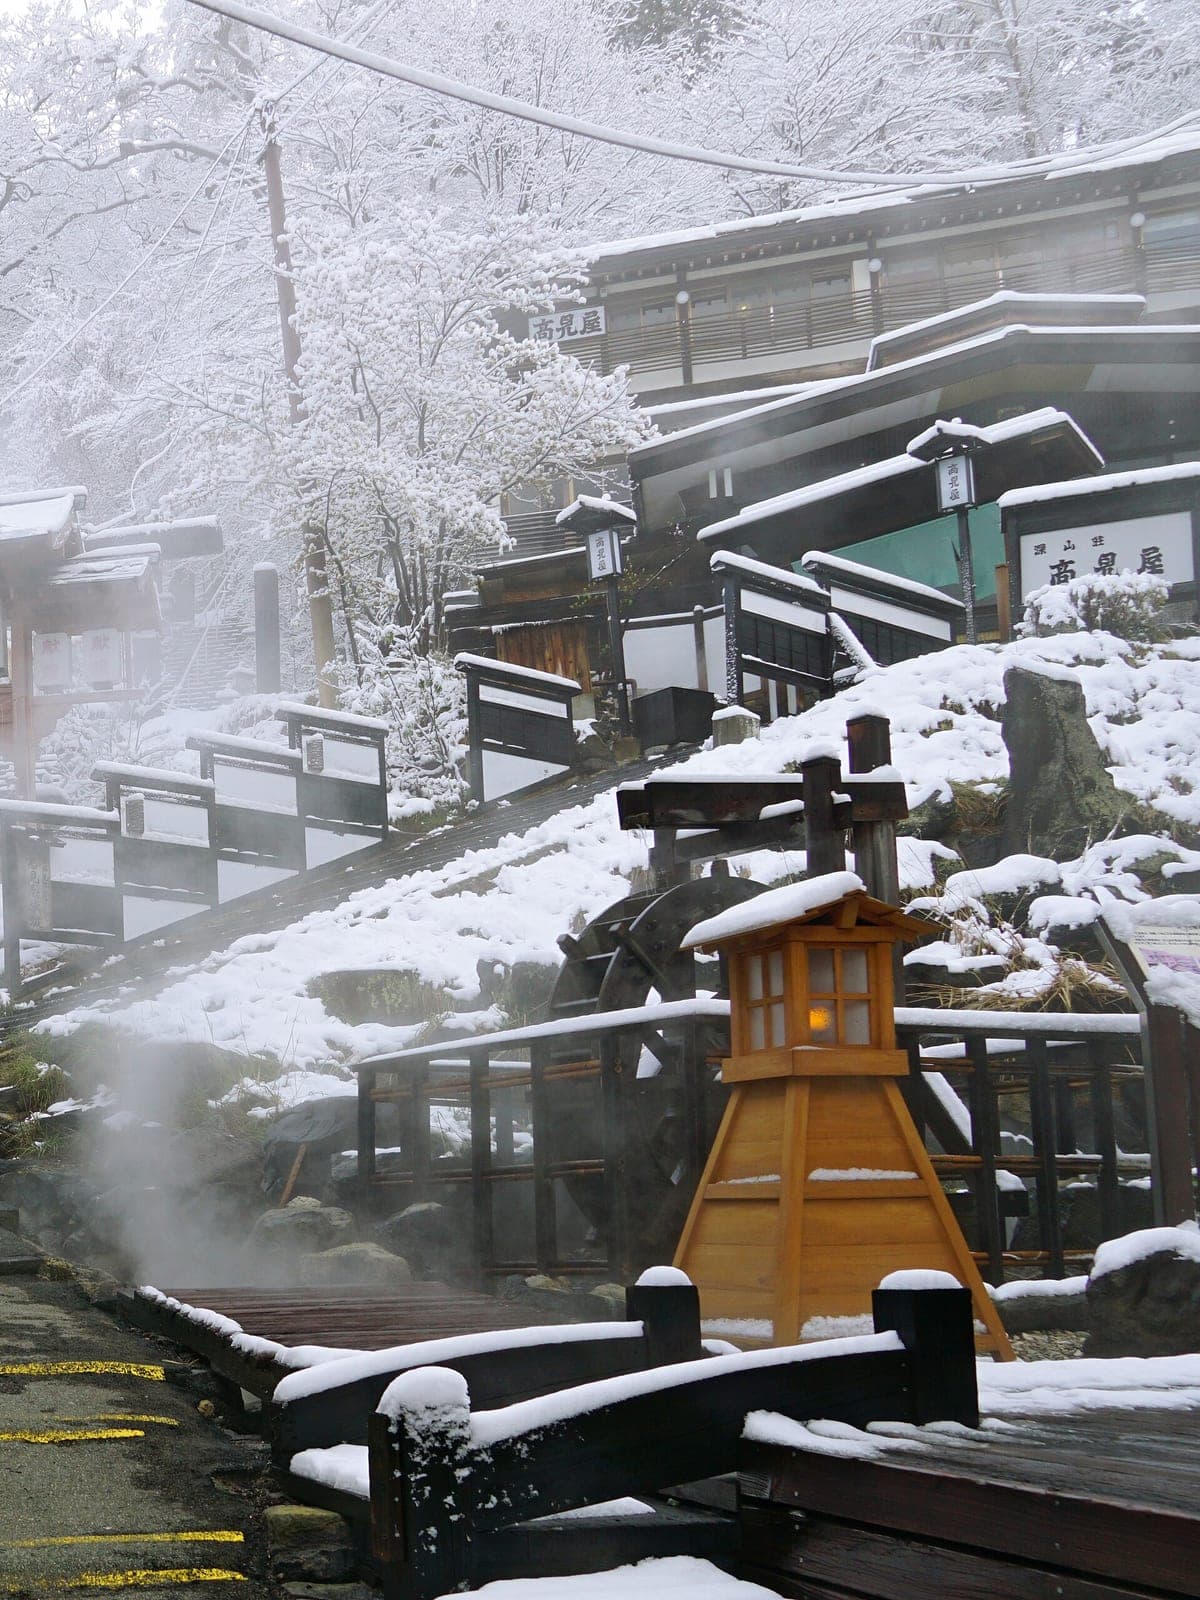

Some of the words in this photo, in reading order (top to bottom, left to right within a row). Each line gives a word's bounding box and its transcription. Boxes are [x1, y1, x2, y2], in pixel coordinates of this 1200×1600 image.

[533, 310, 602, 342] 高見屋
[947, 463, 960, 501] 高見屋
[1034, 535, 1105, 556] 深山荘
[1049, 545, 1165, 586] 高見屋
